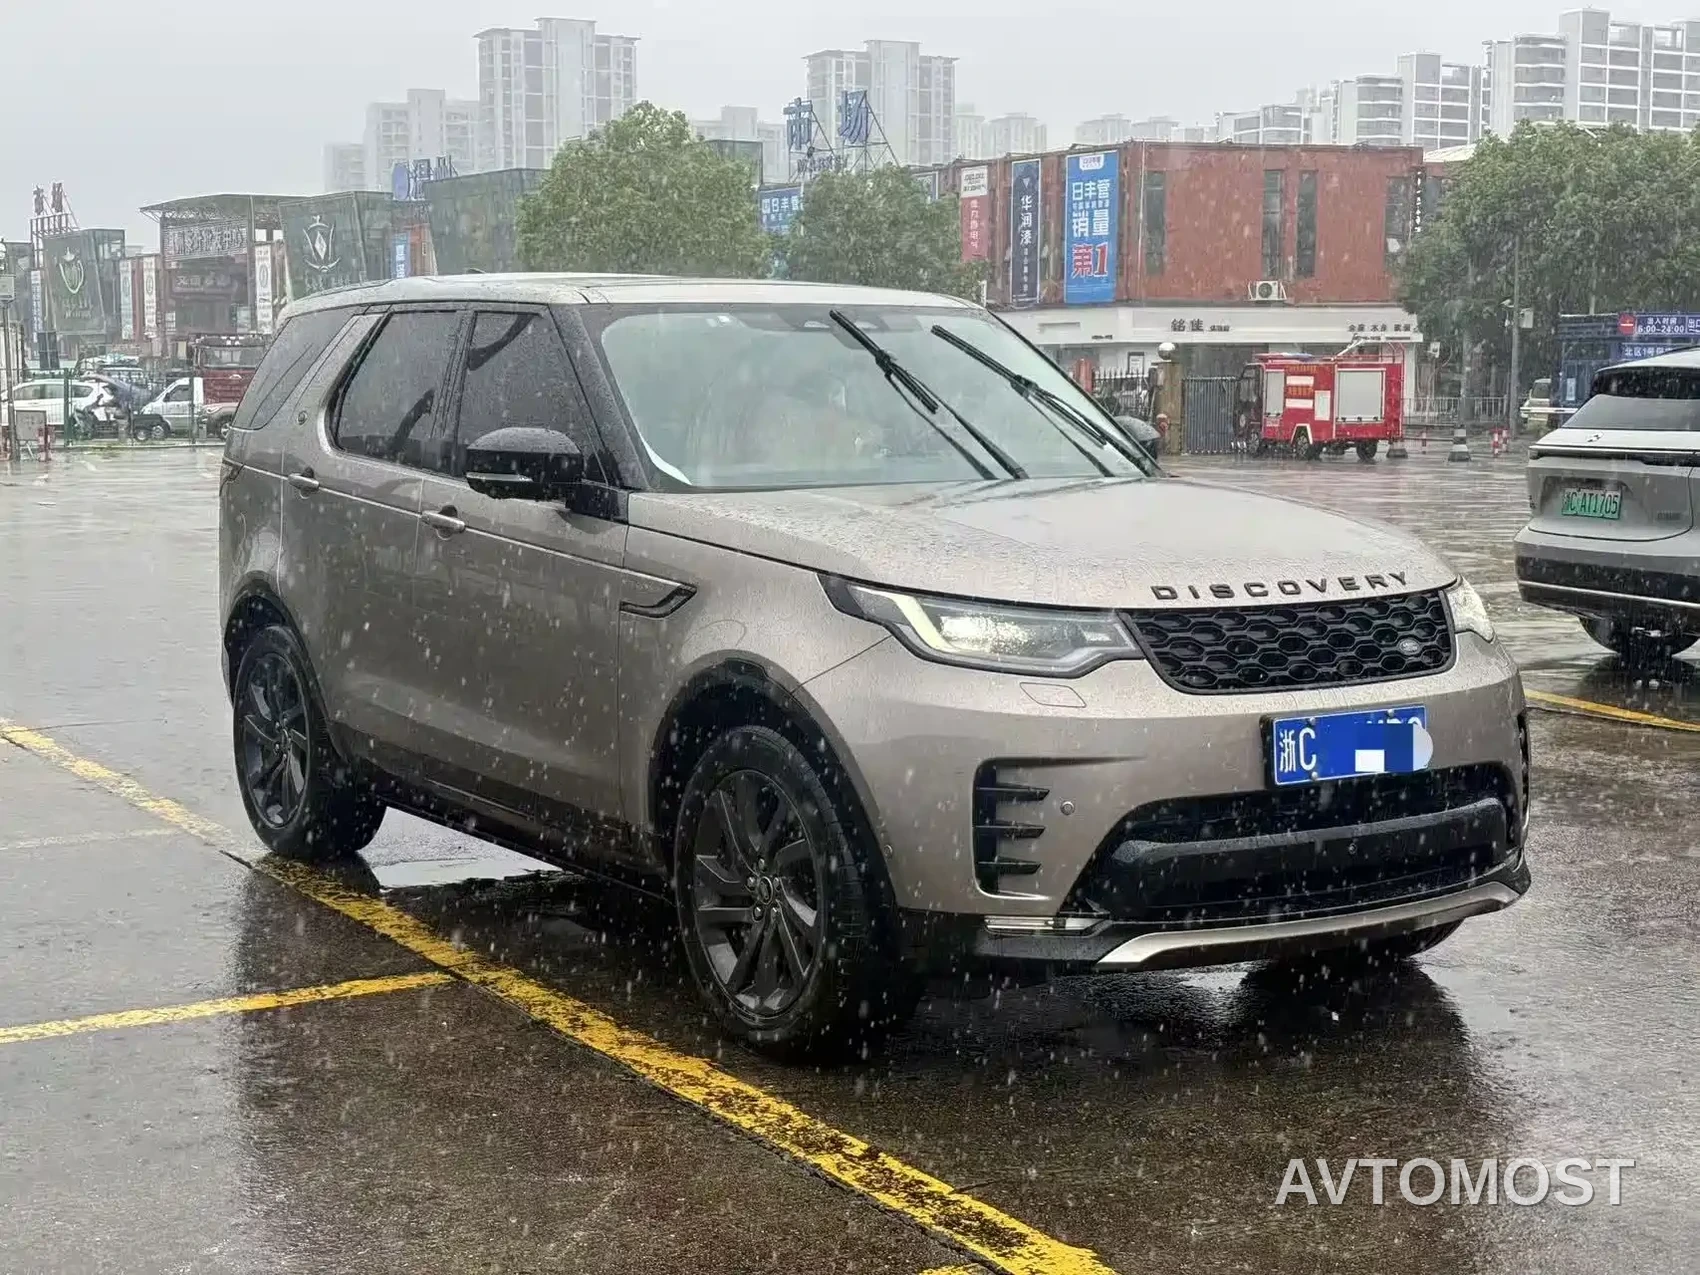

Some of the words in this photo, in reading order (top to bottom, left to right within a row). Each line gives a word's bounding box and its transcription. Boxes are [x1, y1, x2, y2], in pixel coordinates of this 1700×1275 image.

[1072, 179, 1110, 200] 日丰管
[1020, 195, 1032, 245] 华润漆
[1072, 208, 1109, 238] 销量
[1072, 242, 1109, 278] 第1
[1150, 571, 1408, 600] DISCOVERY
